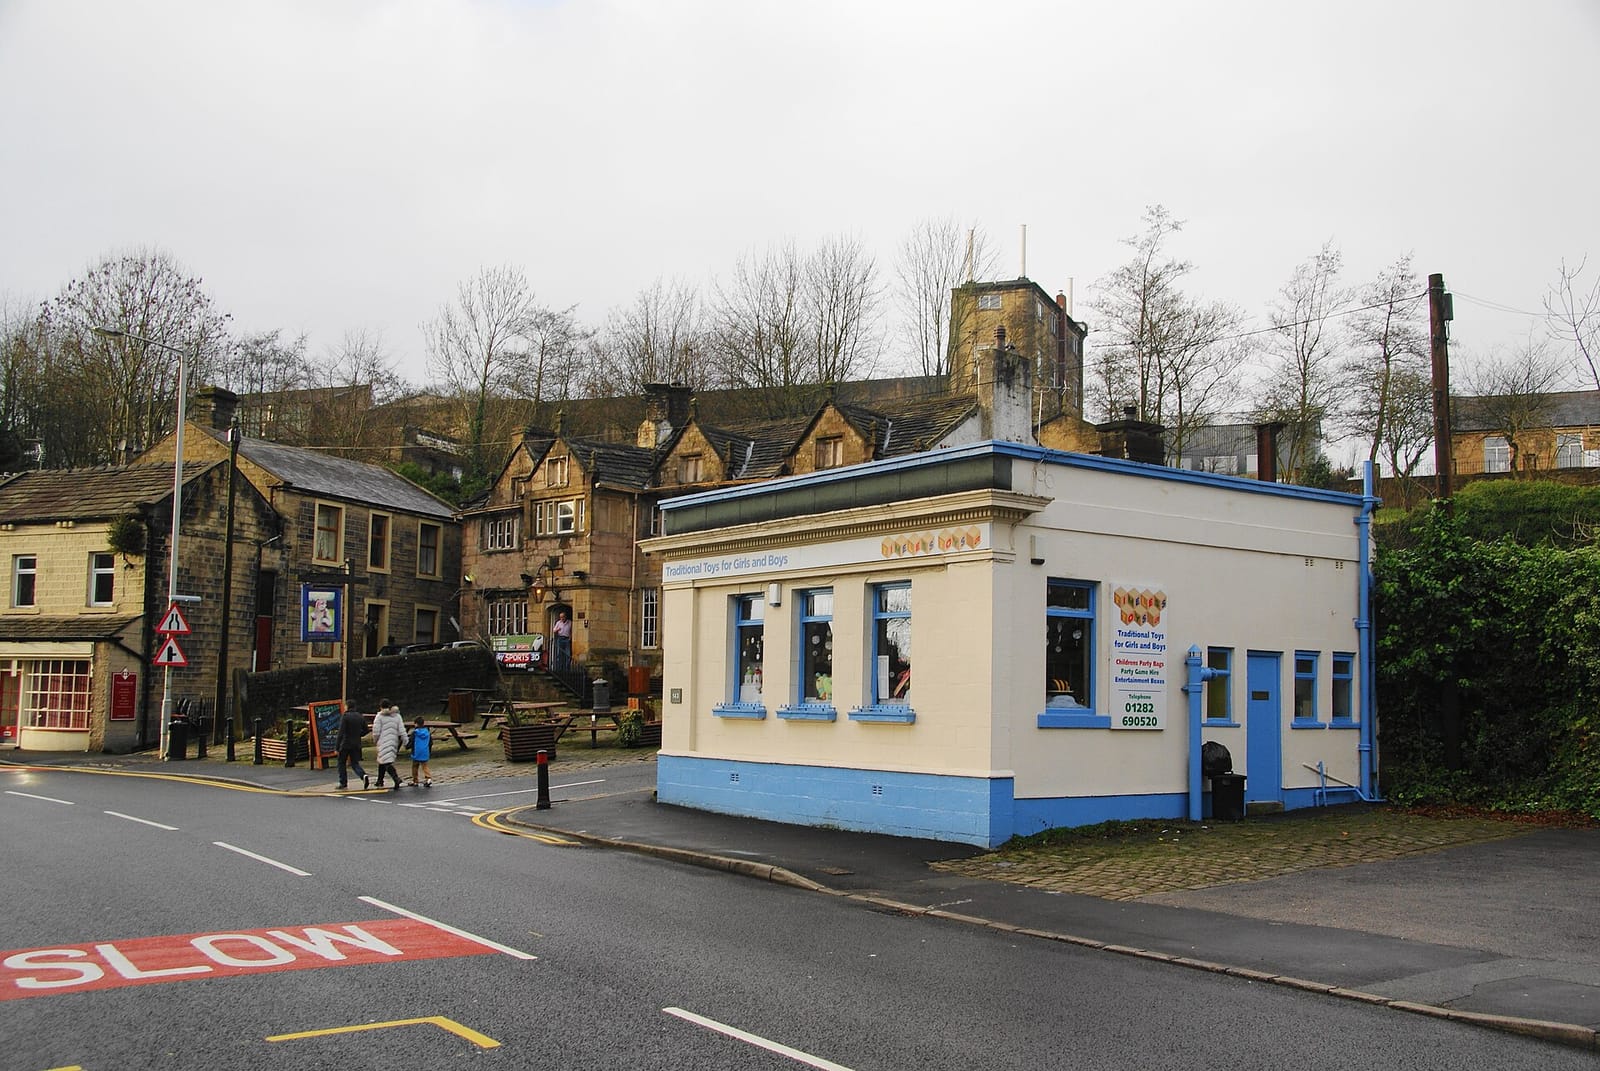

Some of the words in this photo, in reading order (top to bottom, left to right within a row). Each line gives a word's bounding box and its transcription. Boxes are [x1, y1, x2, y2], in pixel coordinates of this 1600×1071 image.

[665, 563, 702, 577] Traditional
[703, 562, 720, 574] Toys
[721, 560, 732, 571] for
[733, 558, 750, 569] Girls
[751, 556, 767, 568] and
[768, 554, 788, 567] Boys
[1117, 629, 1150, 638] Traditional
[1151, 631, 1164, 641] Toys
[1114, 639, 1124, 648] for
[1125, 640, 1139, 649] Girls
[1139, 641, 1151, 649] and
[1152, 642, 1166, 652] Boys
[504, 653, 529, 662] SPORTS
[1115, 658, 1139, 666] Childrens
[1139, 660, 1152, 668] Party
[1153, 661, 1164, 669] Bags
[1120, 668, 1134, 676] Party
[1114, 676, 1150, 684] Entertainment
[1125, 702, 1154, 713] 01282
[1122, 716, 1158, 727] 690520
[3, 925, 404, 989] SLOW
